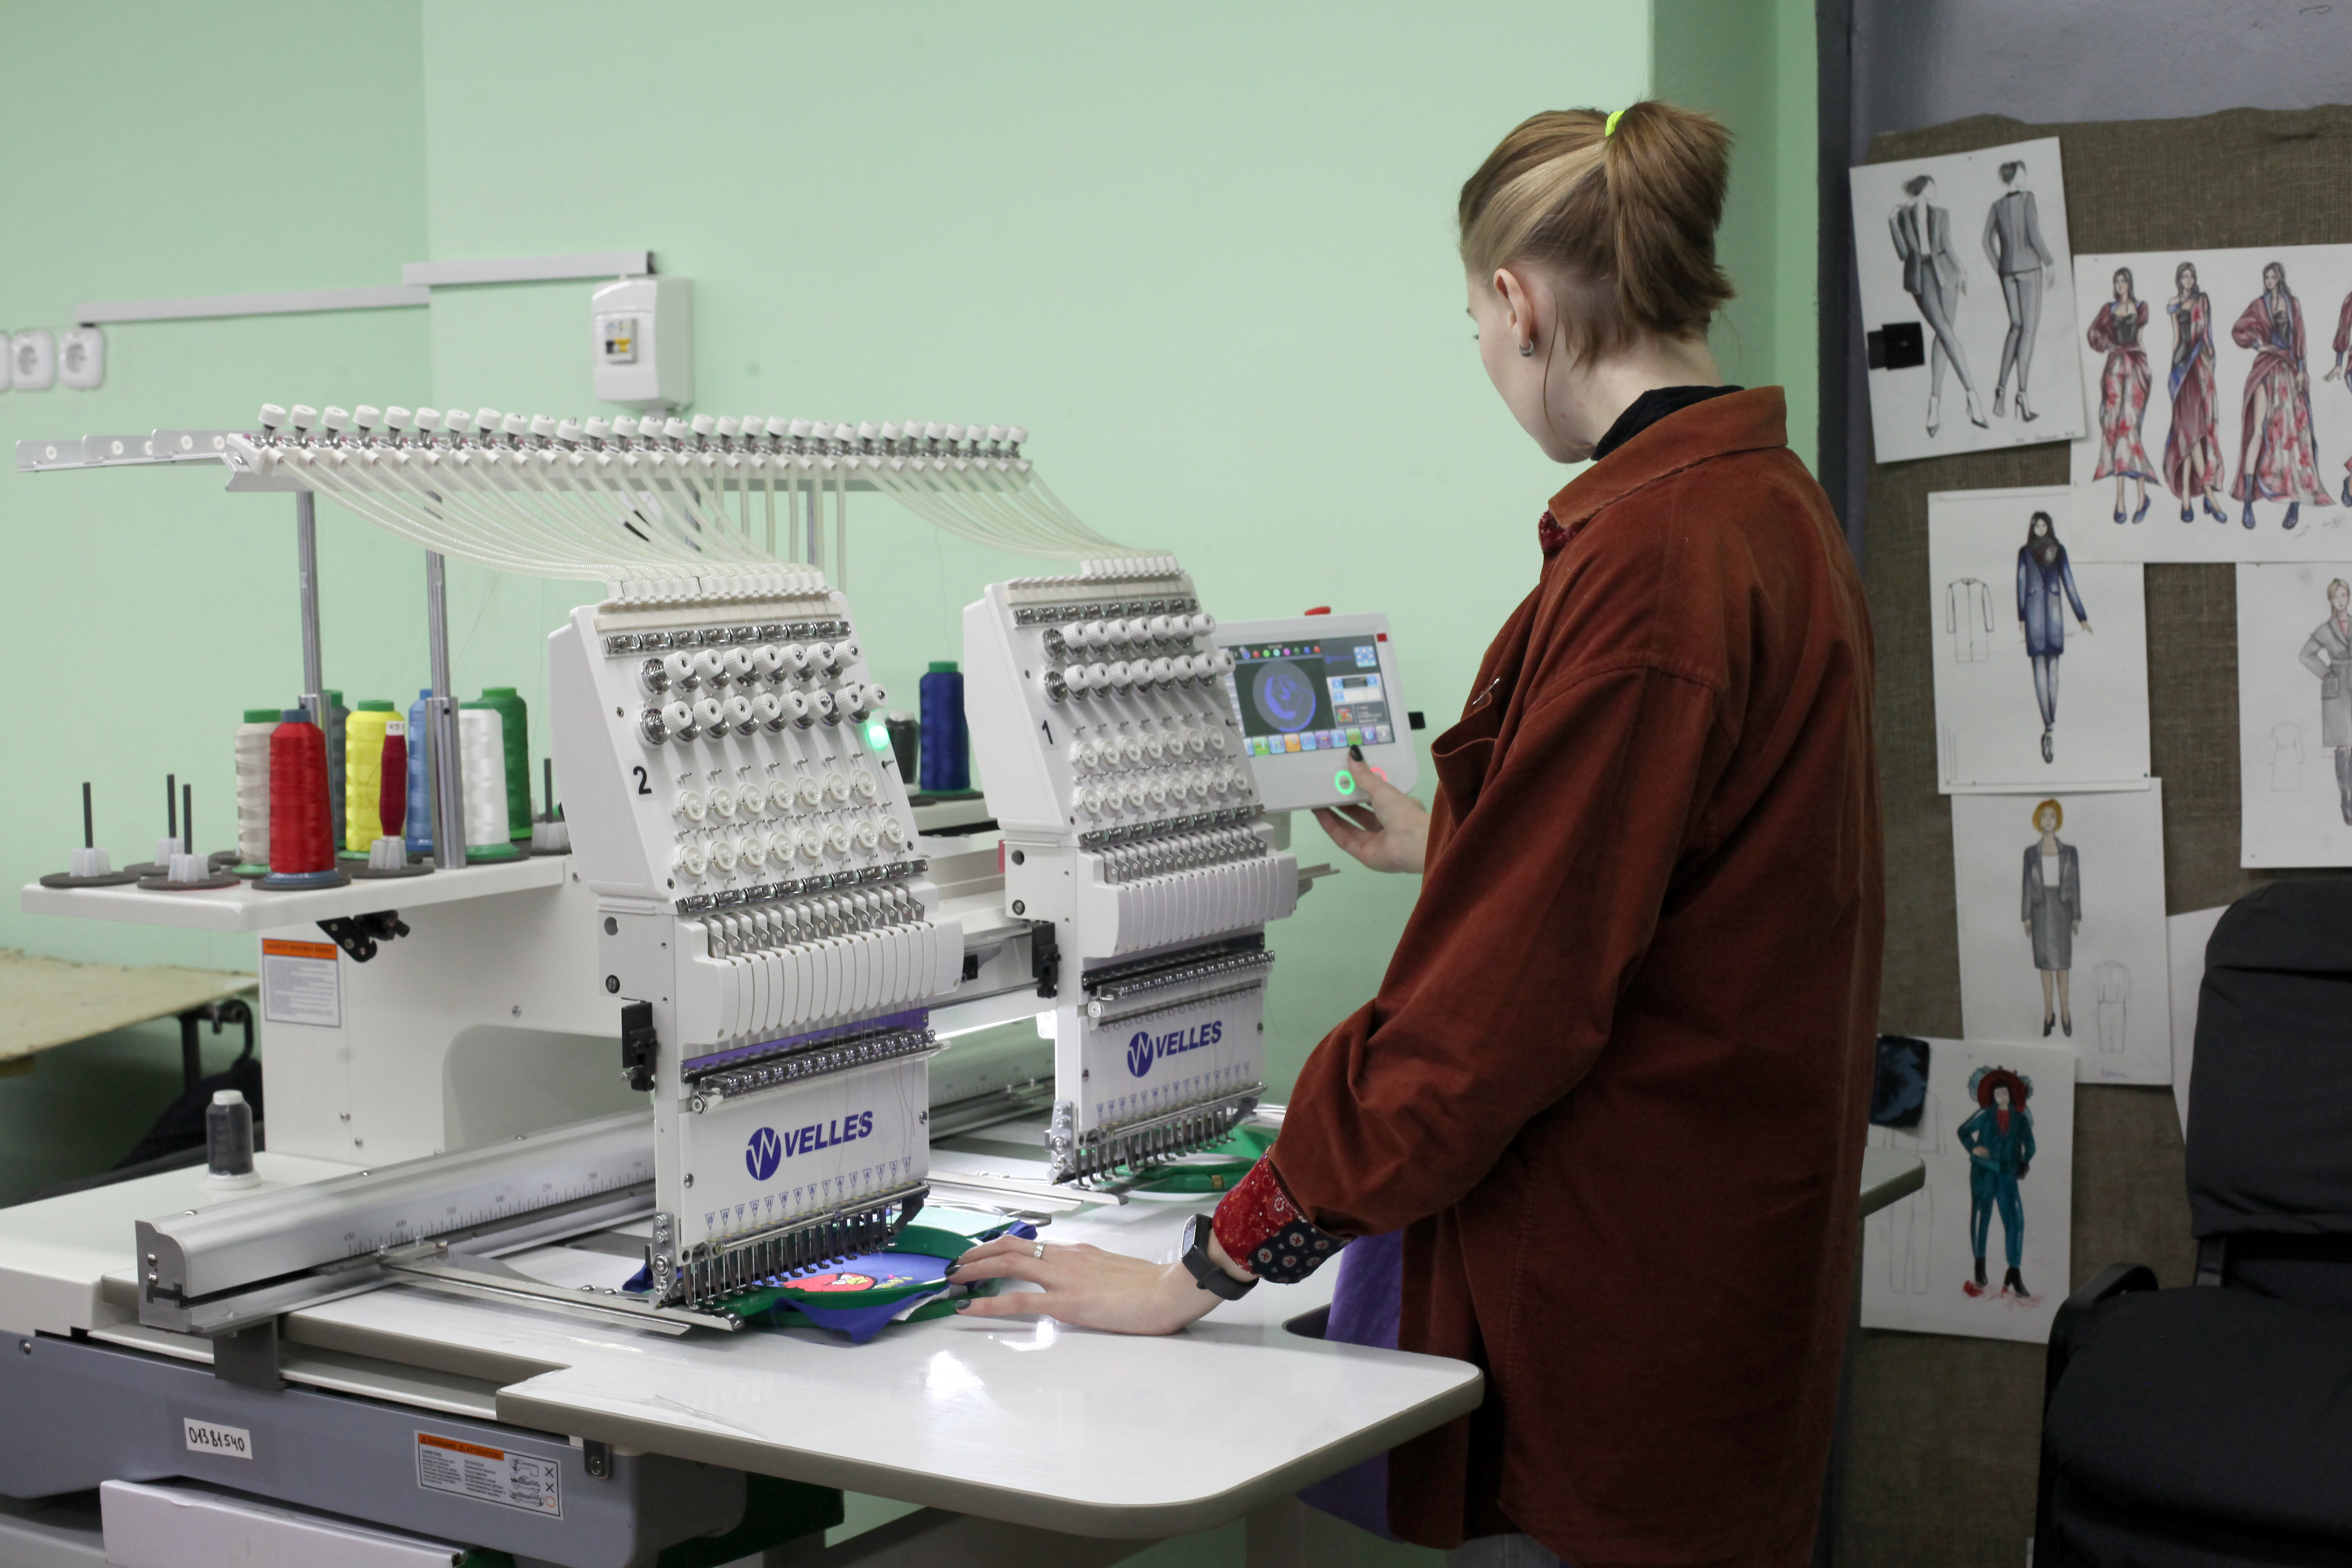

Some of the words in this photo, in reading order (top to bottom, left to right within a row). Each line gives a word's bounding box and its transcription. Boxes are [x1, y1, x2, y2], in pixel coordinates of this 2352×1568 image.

[1042, 720, 1053, 745] 1
[633, 766, 652, 794] 2
[1156, 1020, 1222, 1058] VELLES
[784, 1111, 873, 1158] VELLES
[495, 1195, 505, 1204] 300
[542, 1183, 552, 1191] 250
[588, 1172, 598, 1181] 200
[189, 1426, 245, 1452] 01381540
[428, 1438, 457, 1450] WARNING
[466, 1447, 501, 1459] ATTENTION
